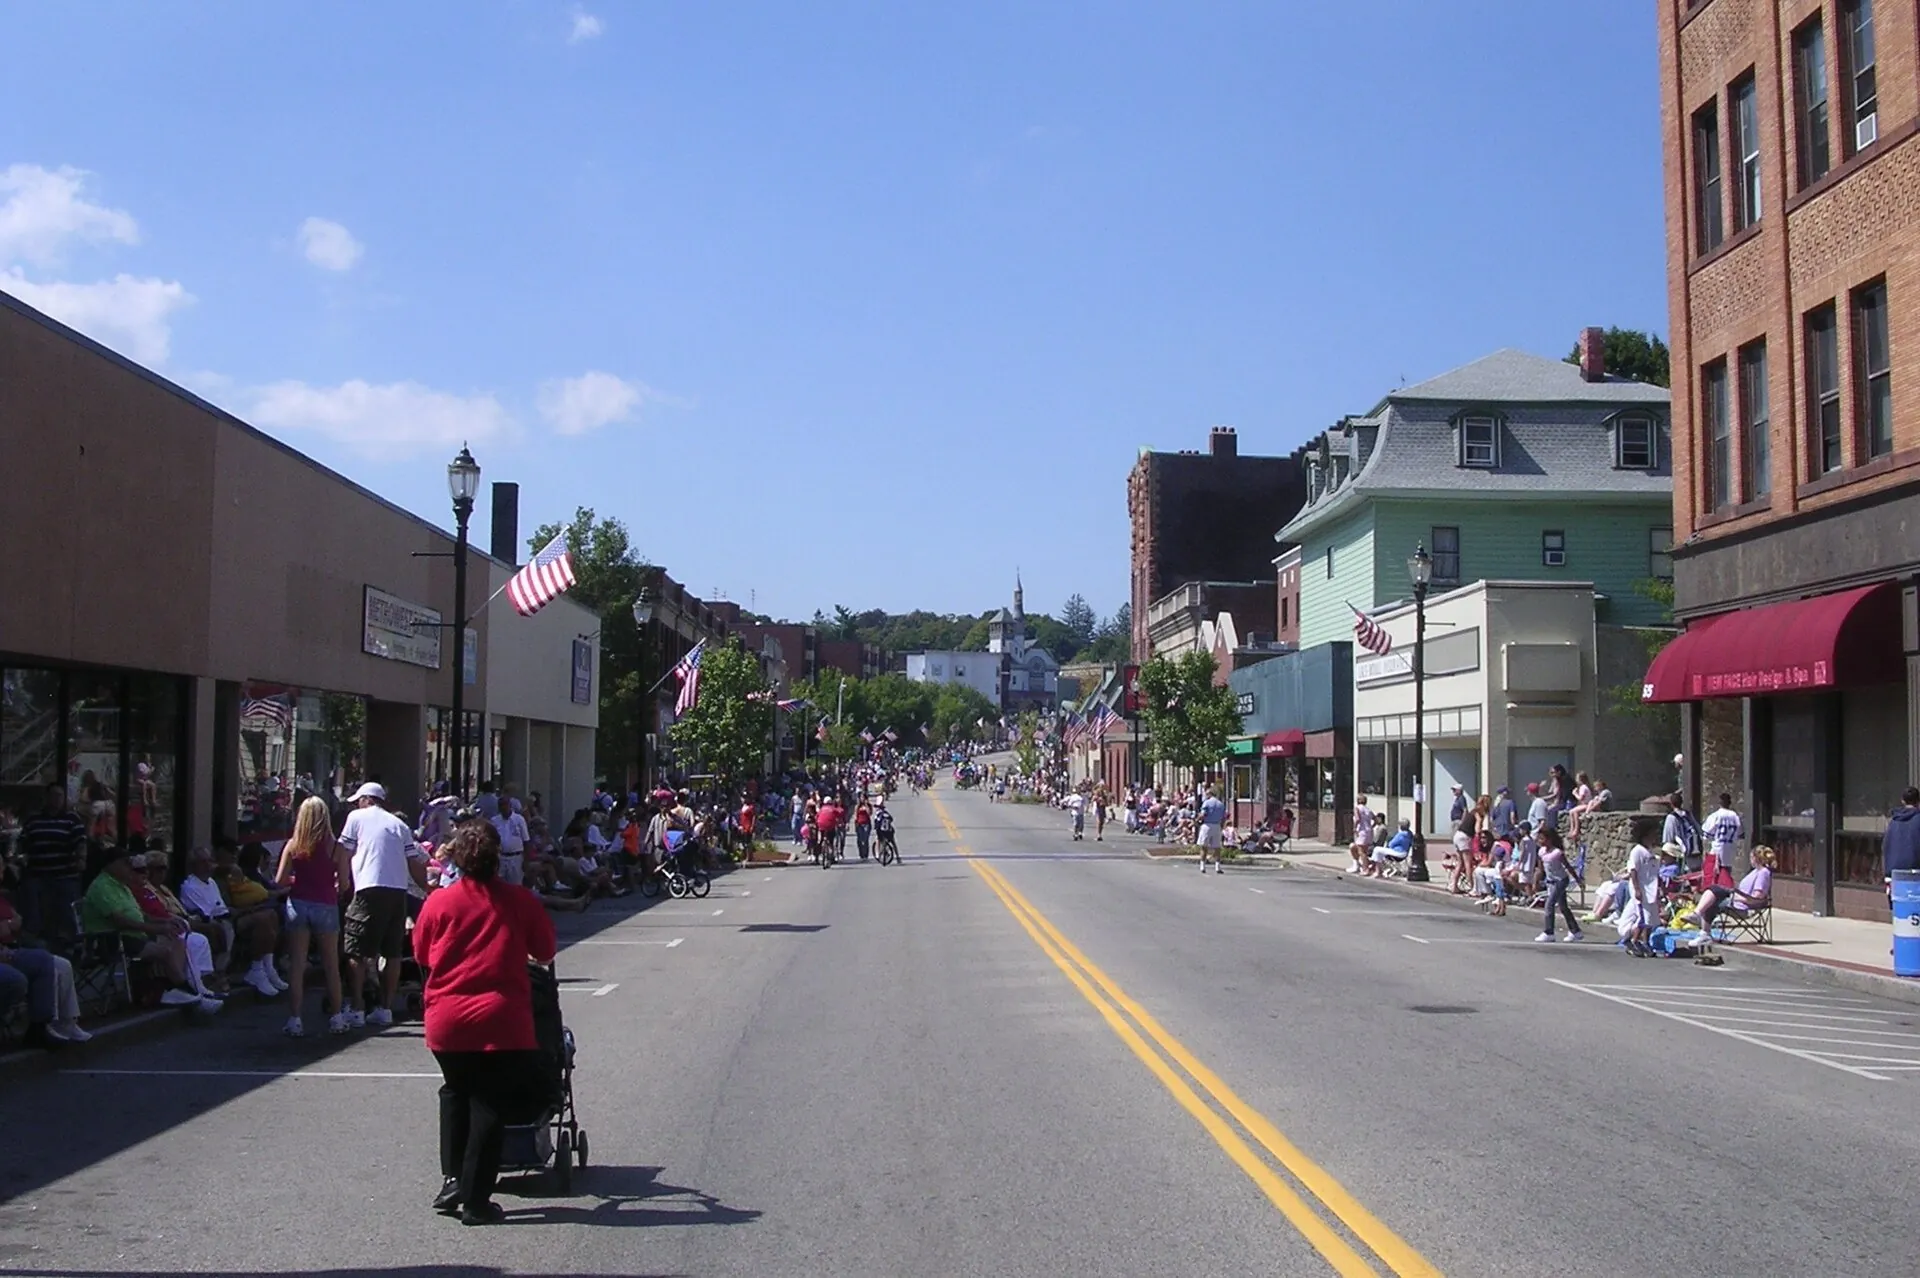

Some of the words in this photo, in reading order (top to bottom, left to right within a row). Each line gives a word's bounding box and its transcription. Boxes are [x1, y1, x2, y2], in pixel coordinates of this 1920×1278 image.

[1742, 671, 1757, 687] Hair
[1759, 669, 1784, 689] Design
[1794, 667, 1808, 686] Spa
[1718, 824, 1738, 843] 27
